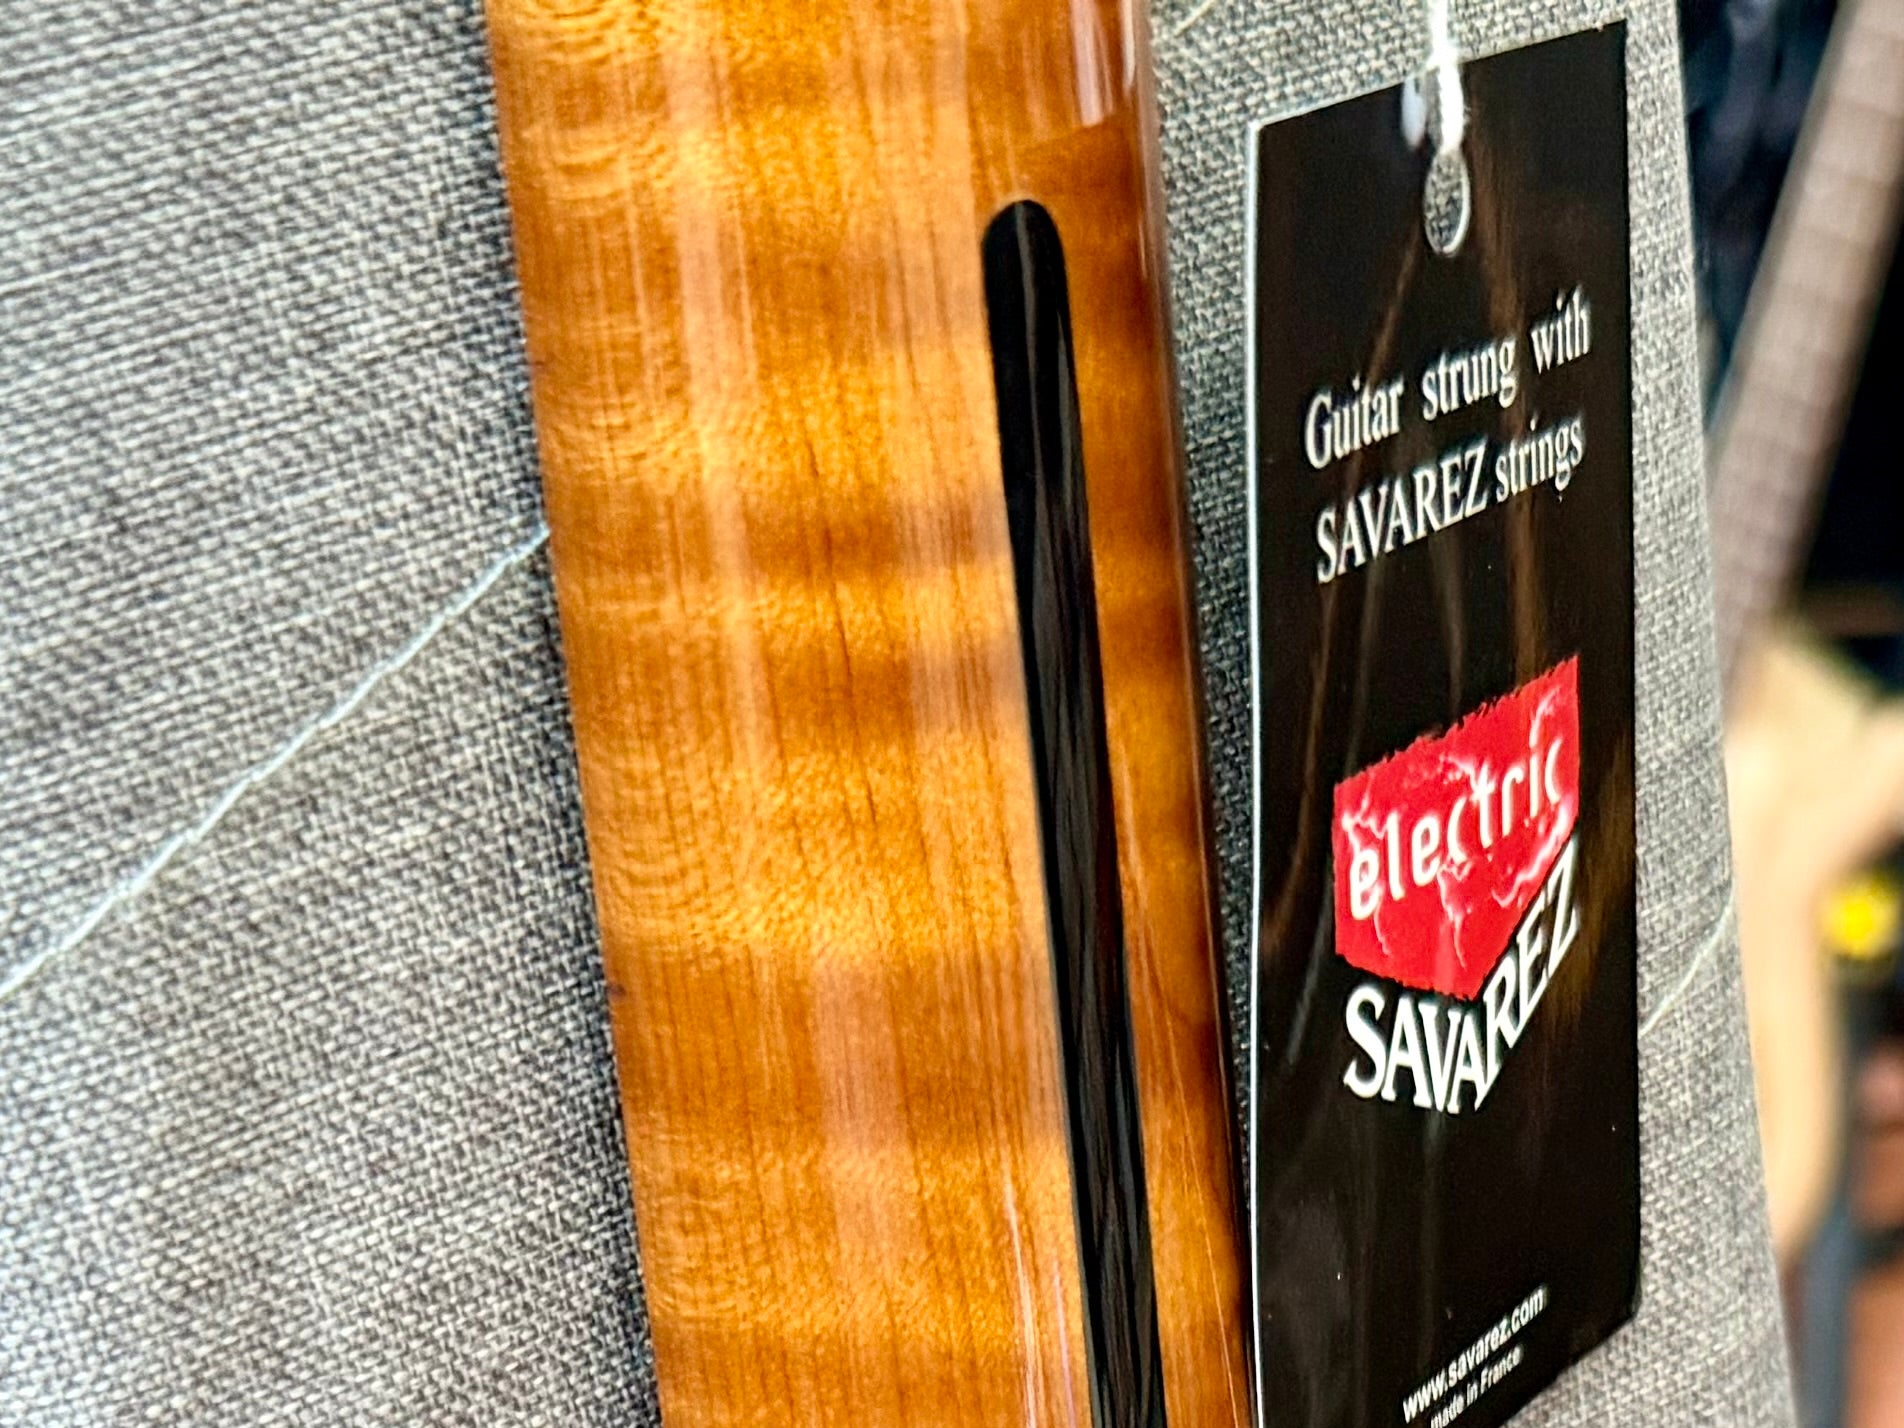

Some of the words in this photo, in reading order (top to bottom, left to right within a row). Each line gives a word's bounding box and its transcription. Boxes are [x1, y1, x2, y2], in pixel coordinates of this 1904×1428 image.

[1304, 372, 1404, 470] Guitar
[1422, 336, 1517, 421] strung
[1530, 285, 1591, 374] with
[1316, 437, 1489, 584] SAVAREZ
[1495, 412, 1583, 503] strings
[1348, 726, 1564, 921] electric
[1343, 835, 1579, 1115] SAVAREZ
[1402, 1283, 1547, 1424] www.savarez.com
[1466, 1381, 1478, 1406] in
[1480, 1343, 1523, 1395] France
